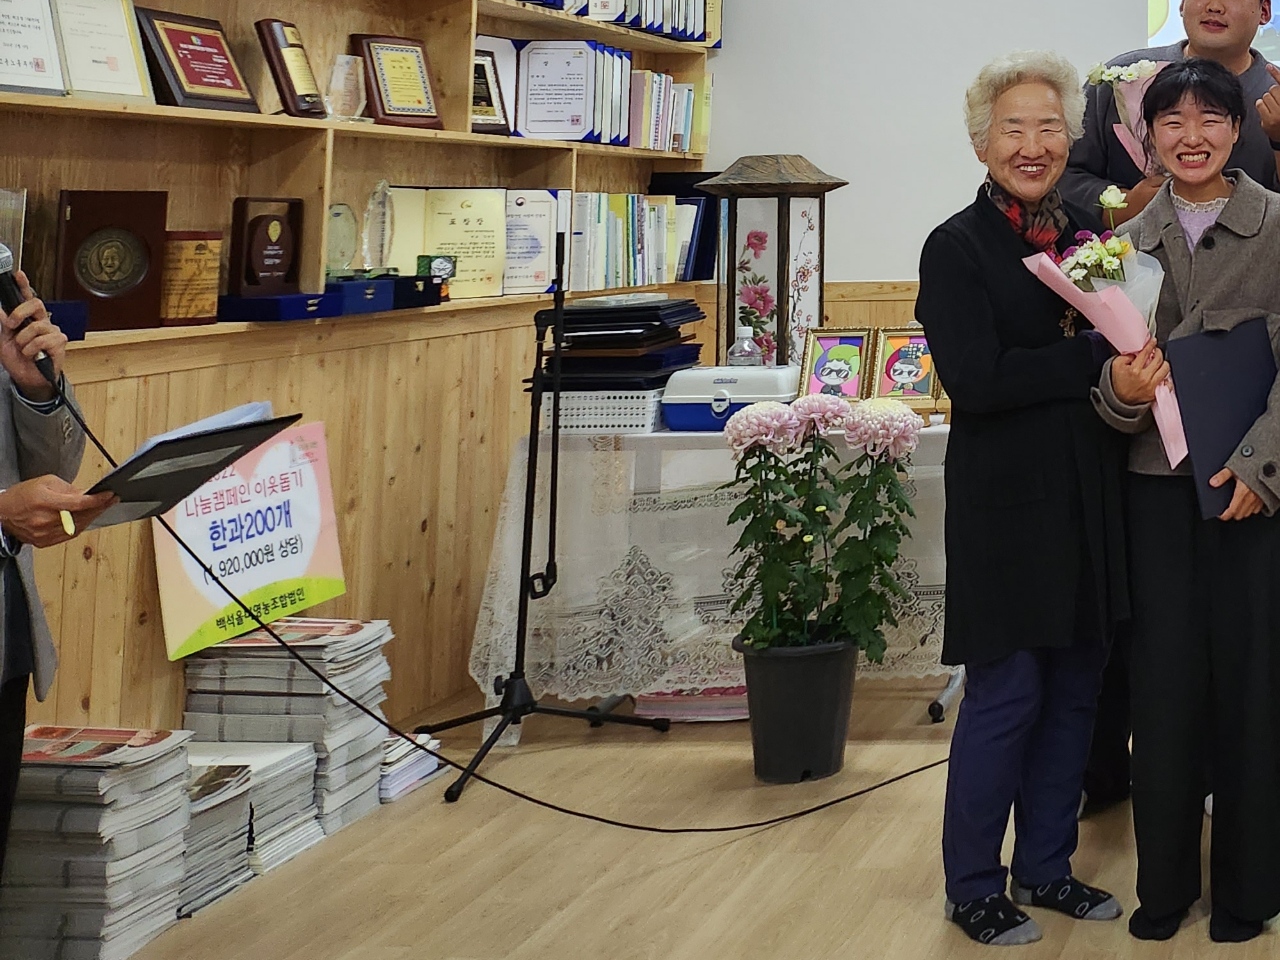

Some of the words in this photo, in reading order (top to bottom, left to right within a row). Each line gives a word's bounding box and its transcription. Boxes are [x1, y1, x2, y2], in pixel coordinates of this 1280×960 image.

[185, 482, 252, 518] 나눔캠페인
[254, 468, 304, 498] 이웃돕기
[208, 464, 237, 483] 022
[209, 499, 293, 552] 한과200개
[203, 542, 275, 586] (920,000원
[279, 534, 304, 559] 상당)
